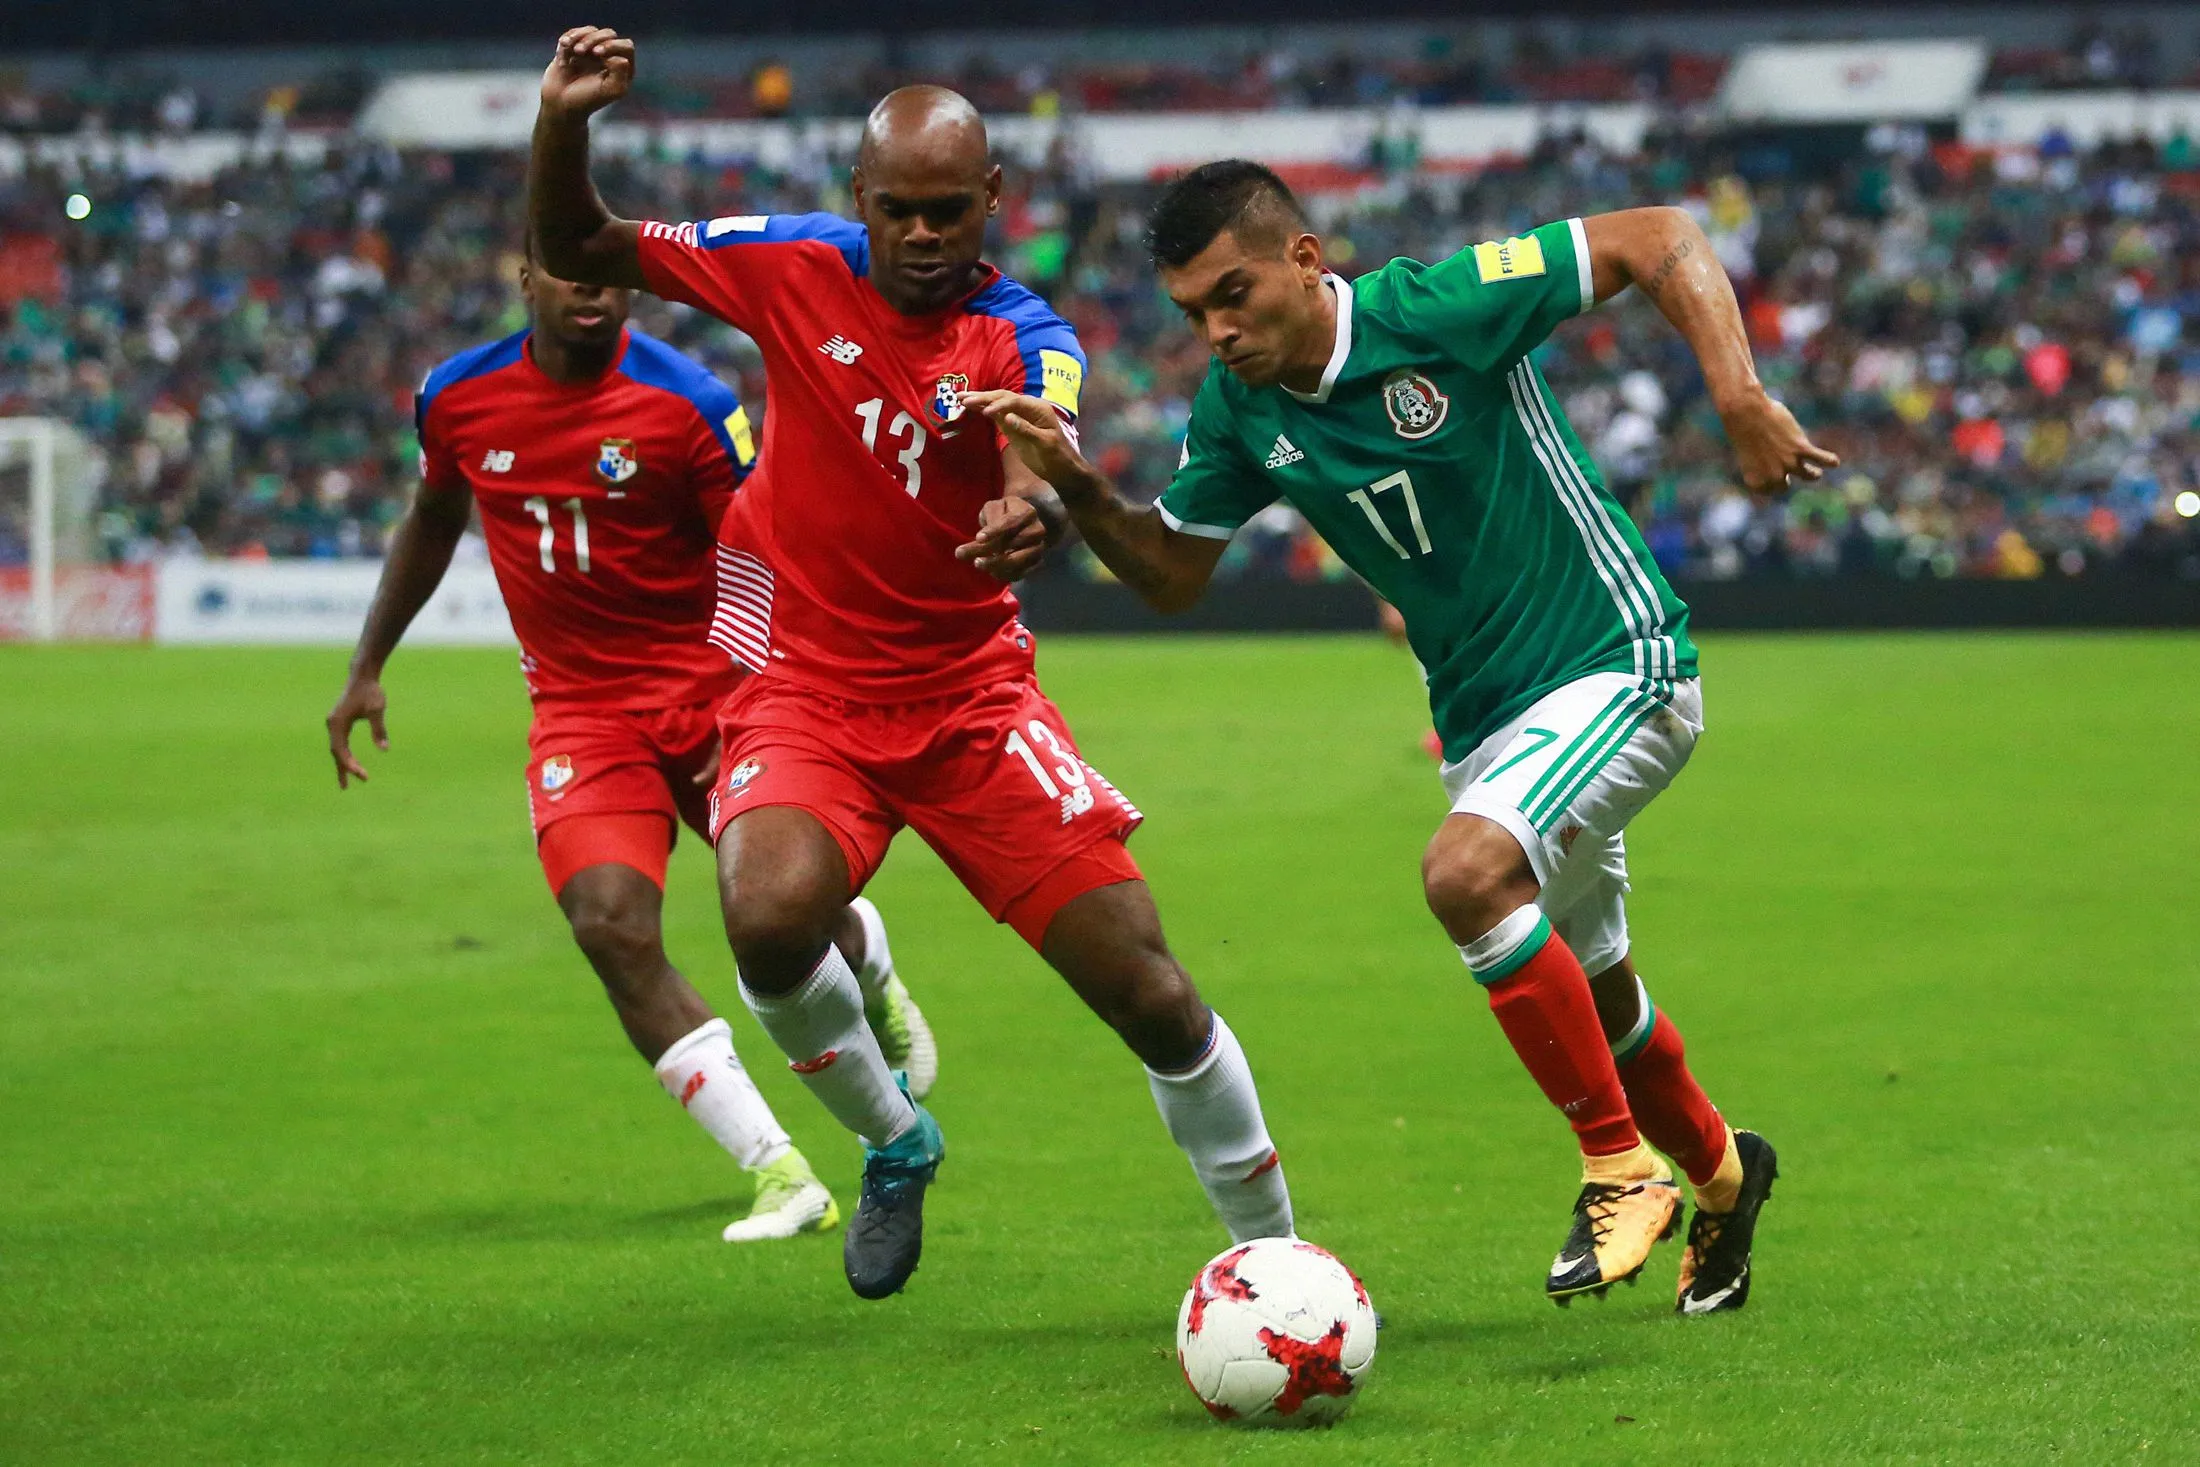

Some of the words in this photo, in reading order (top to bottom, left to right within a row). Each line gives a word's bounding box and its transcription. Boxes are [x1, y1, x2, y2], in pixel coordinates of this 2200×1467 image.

[1499, 247, 1513, 274] FIFA
[1048, 367, 1072, 383] FIFA
[854, 397, 927, 499] 13
[1265, 450, 1304, 469] adidas
[523, 495, 591, 573] 11
[1346, 469, 1433, 560] 17
[1004, 719, 1086, 800] 13
